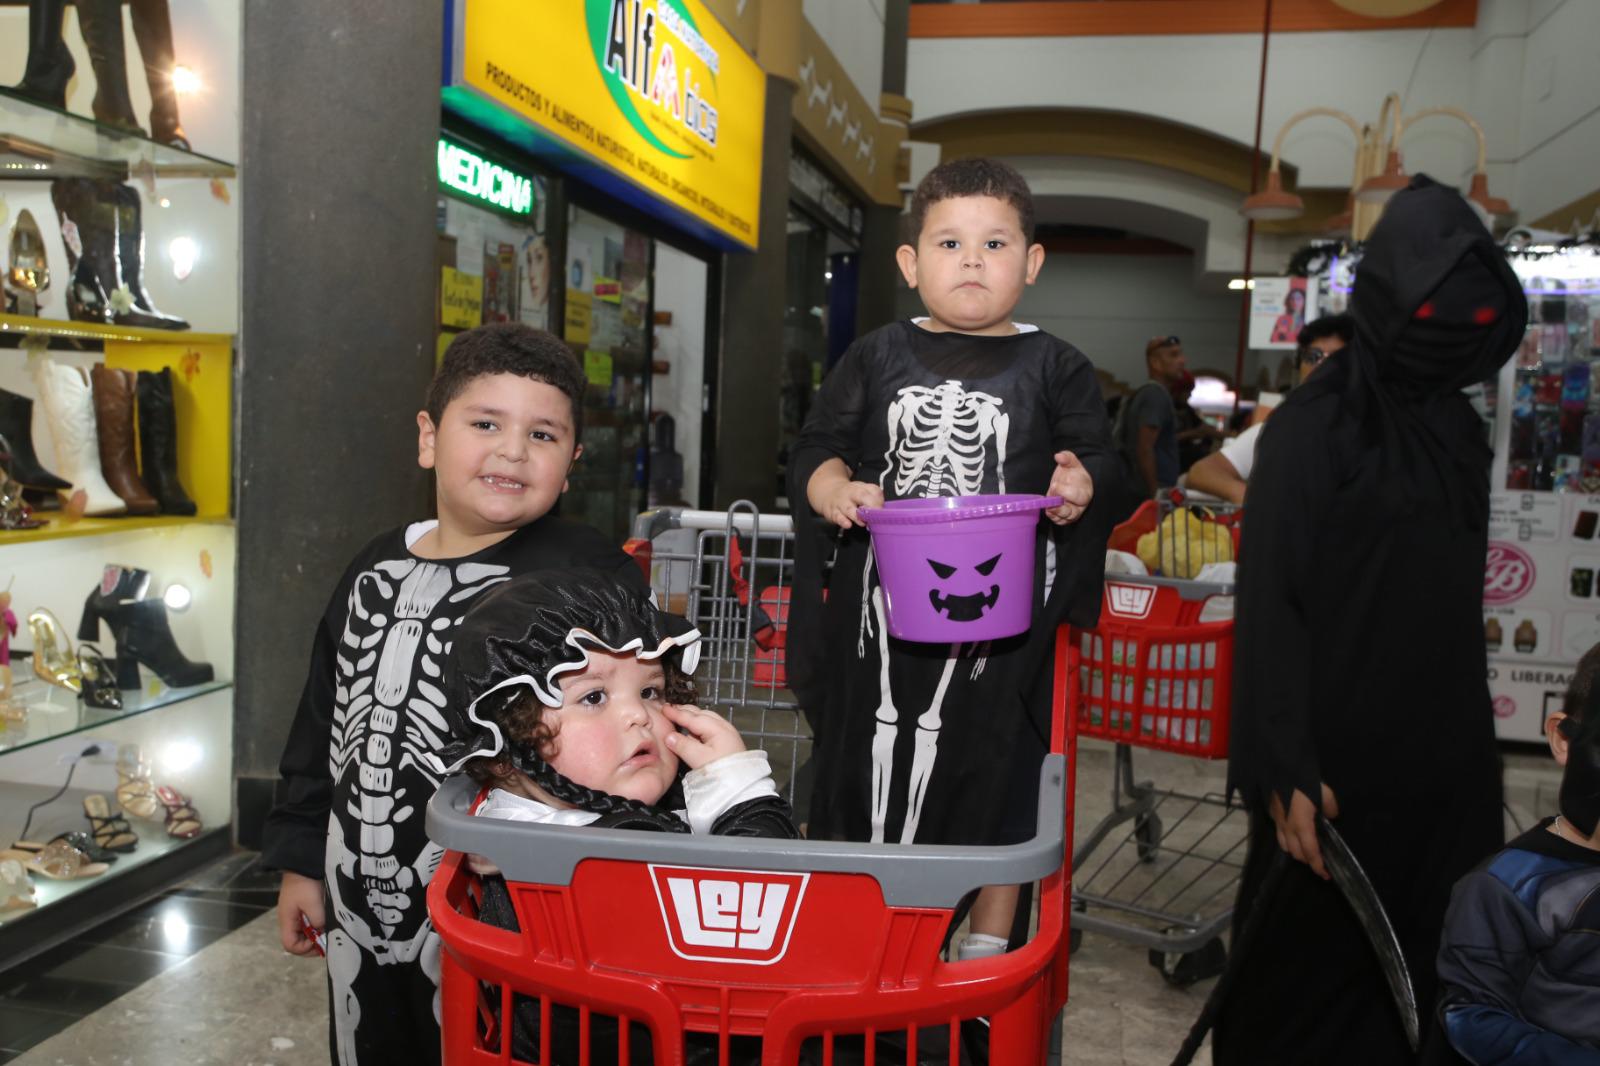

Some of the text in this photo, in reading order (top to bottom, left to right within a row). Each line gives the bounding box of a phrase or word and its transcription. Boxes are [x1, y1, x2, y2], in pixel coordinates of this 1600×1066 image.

[485, 61, 541, 111] PRODUCTOS
[543, 98, 550, 116] Y
[551, 104, 595, 143] ALIMENTOS
[437, 139, 532, 214] MEDICINA
[1109, 585, 1151, 615] Ley
[666, 877, 790, 951] Ley
